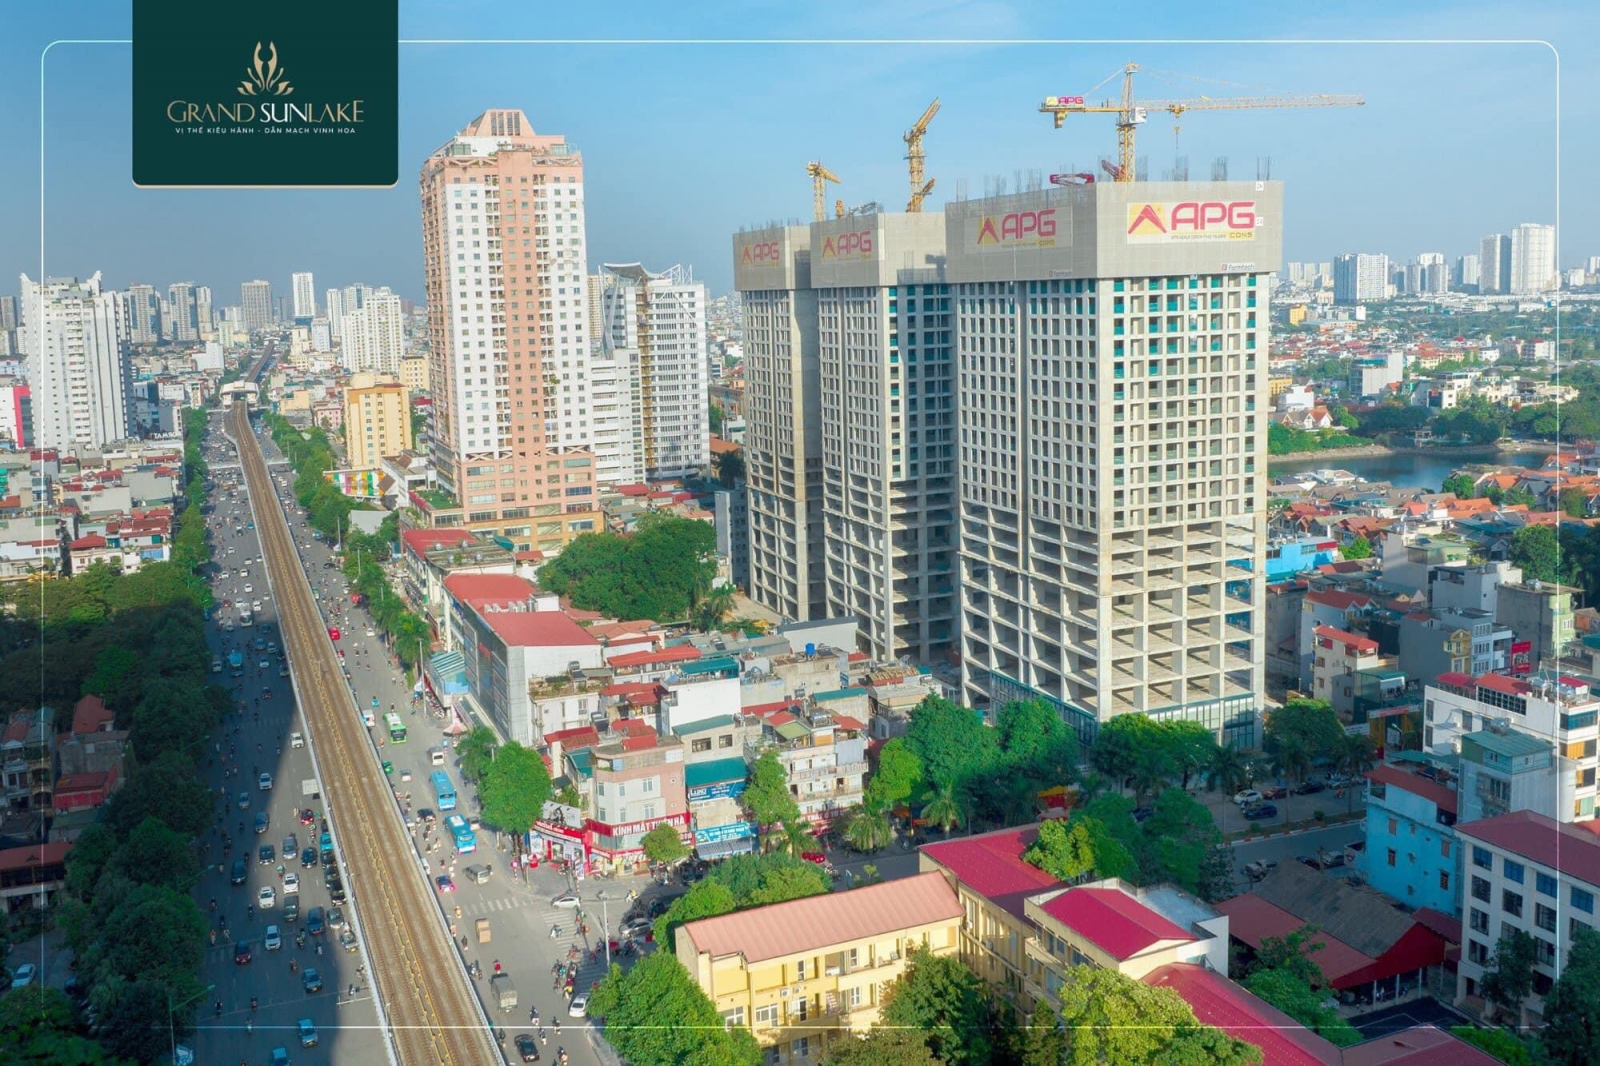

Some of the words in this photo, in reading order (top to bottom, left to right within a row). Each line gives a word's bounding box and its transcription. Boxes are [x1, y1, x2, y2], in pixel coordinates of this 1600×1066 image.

[1002, 209, 1056, 240] APG
[1171, 202, 1255, 230] APG
[837, 231, 872, 254] APG
[1229, 231, 1253, 239] CONS
[753, 242, 780, 262] APG
[612, 825, 632, 837] KÍNH
